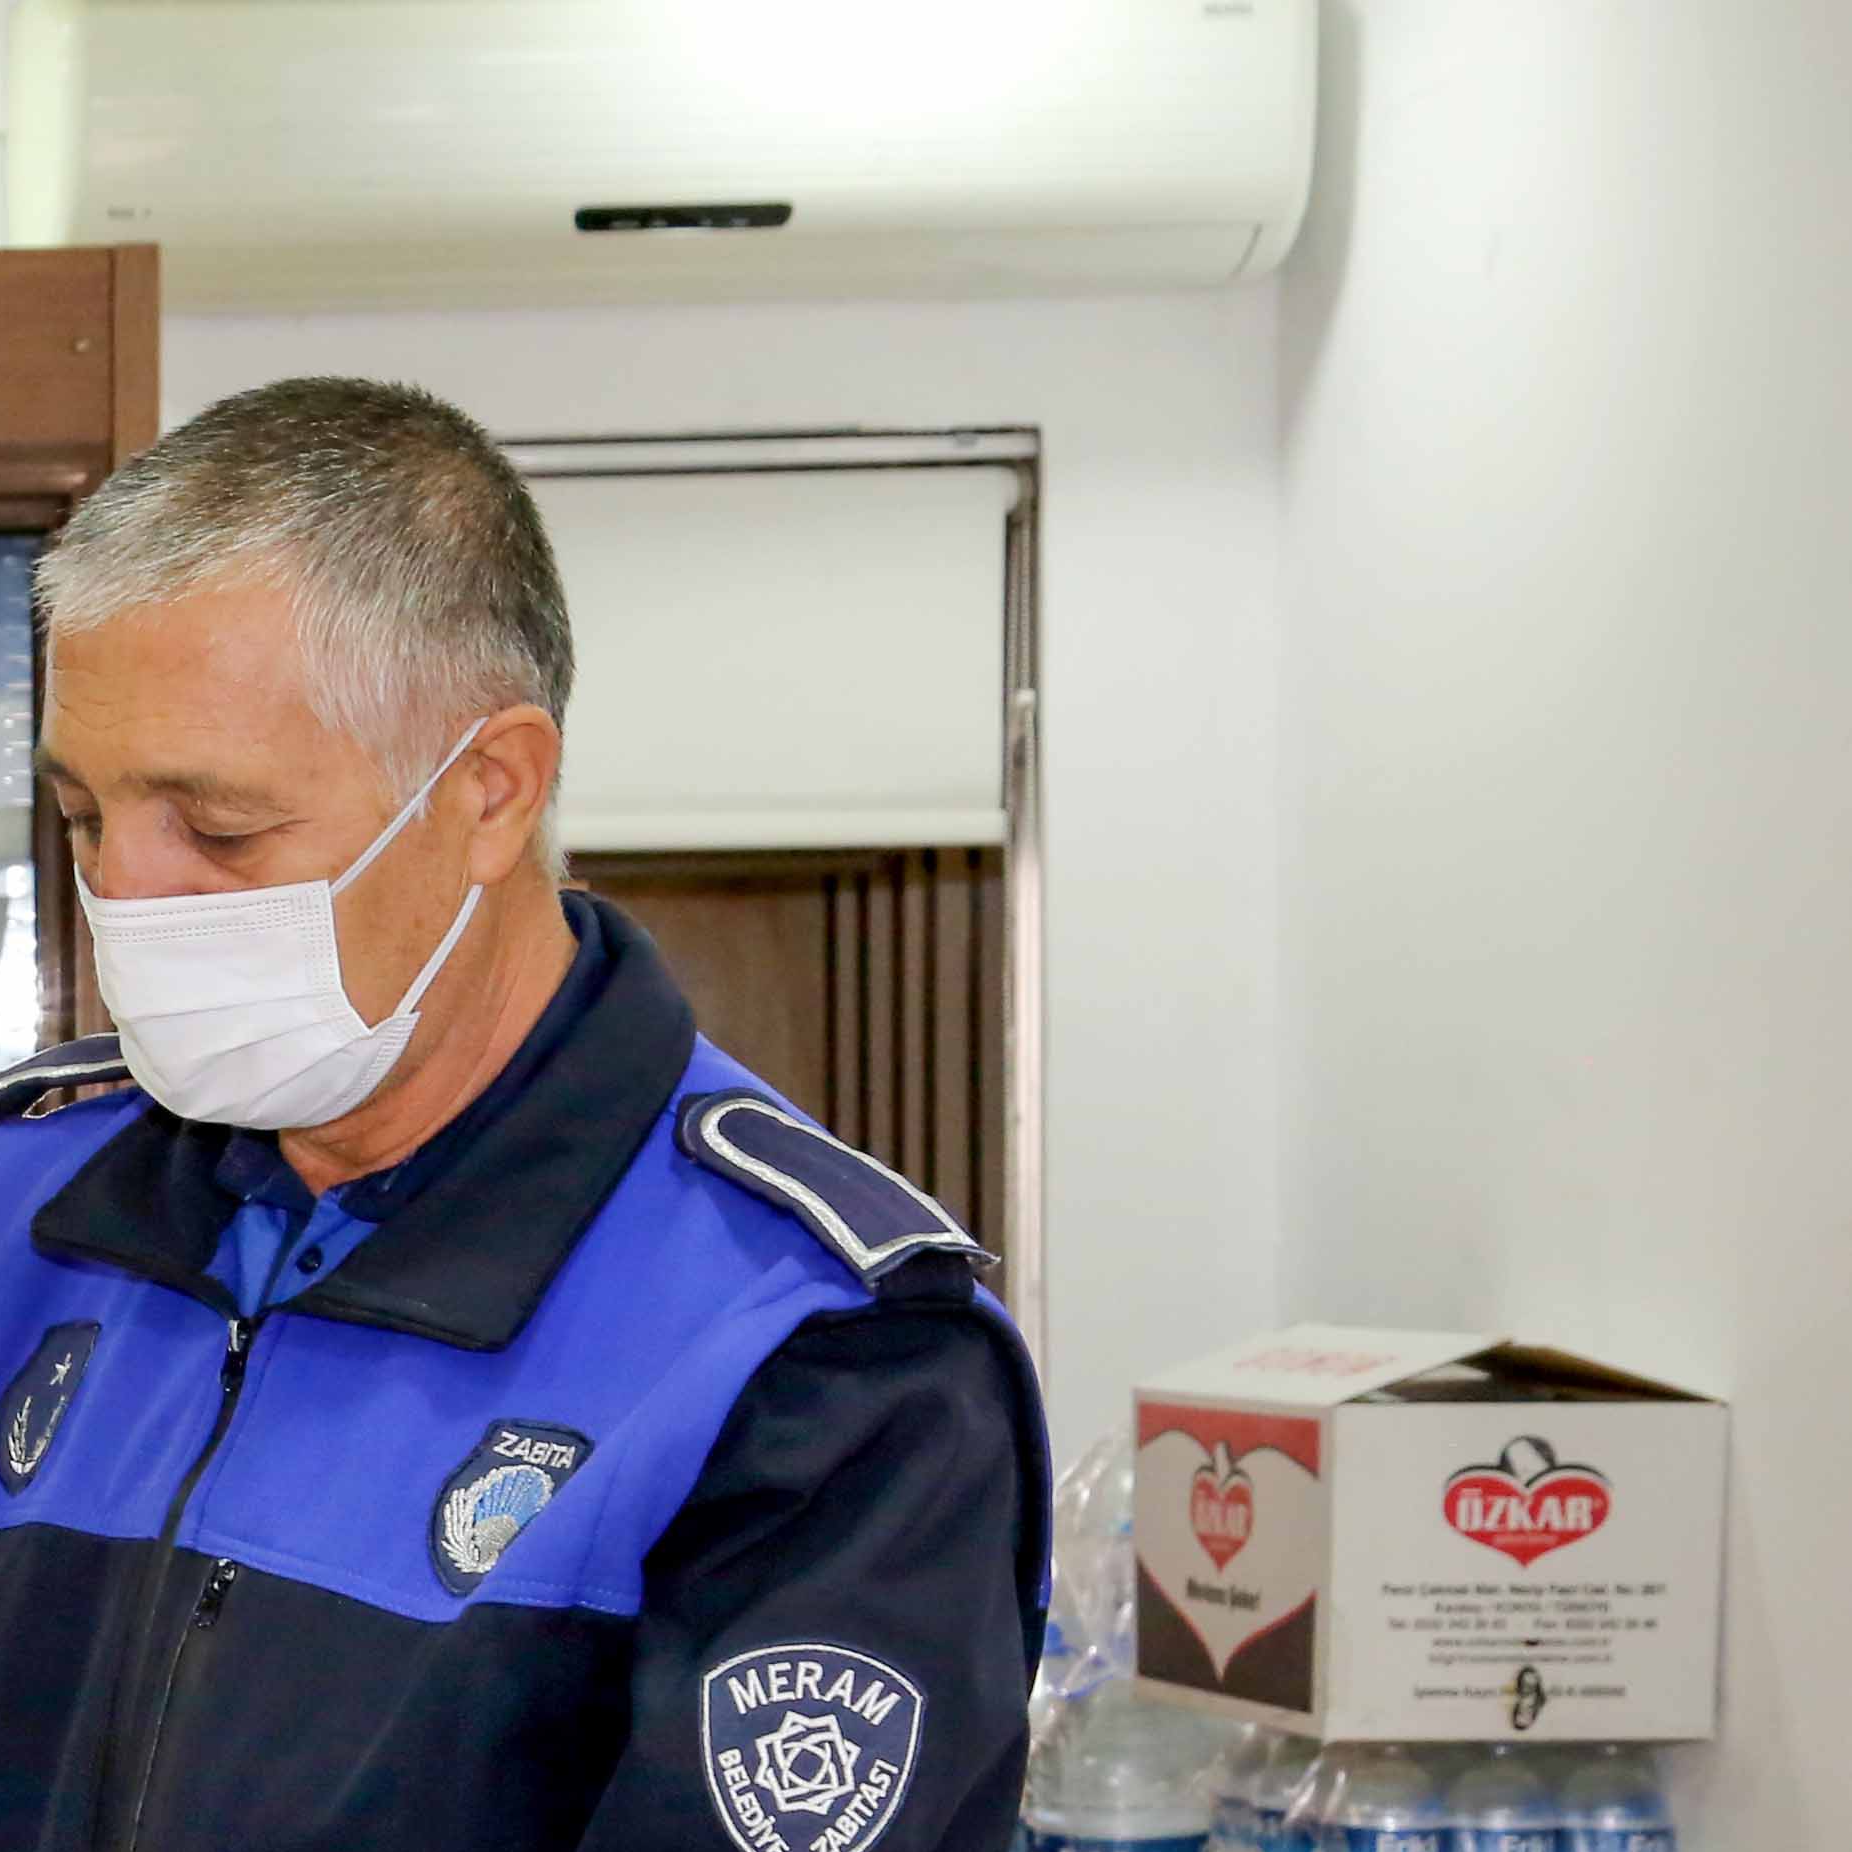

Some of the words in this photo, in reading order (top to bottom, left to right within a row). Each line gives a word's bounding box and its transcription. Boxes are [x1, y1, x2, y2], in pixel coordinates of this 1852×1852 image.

[492, 1431, 576, 1469] ZABITA
[1456, 1487, 1595, 1531] ÖZKAR
[726, 1660, 902, 1727] MERAM
